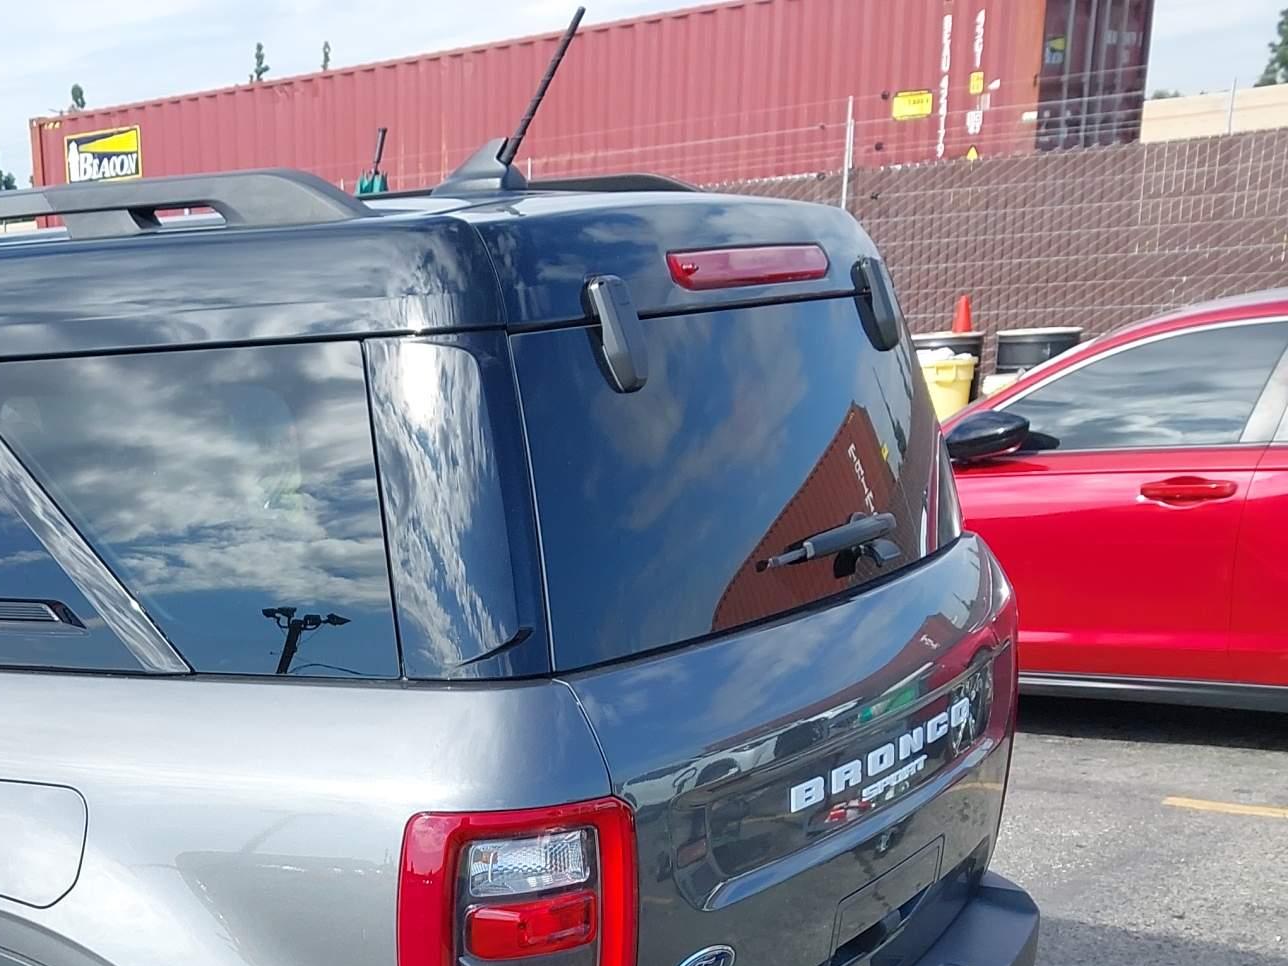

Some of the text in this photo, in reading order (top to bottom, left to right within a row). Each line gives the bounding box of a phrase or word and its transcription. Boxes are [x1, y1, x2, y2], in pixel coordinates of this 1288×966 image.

[80, 153, 137, 180] BEACON
[791, 697, 969, 813] BRONCO
[862, 755, 927, 802] SPORT
